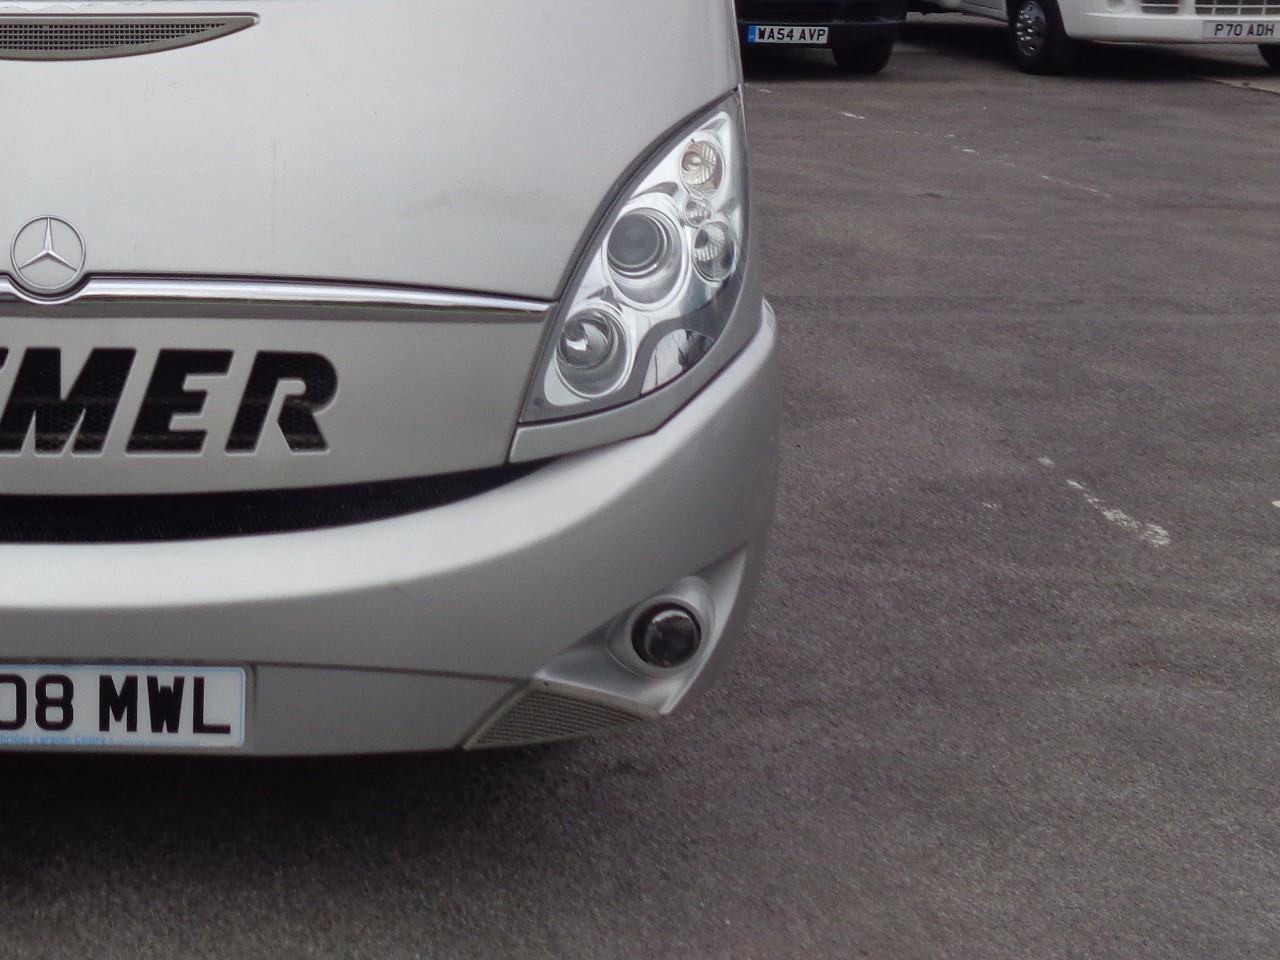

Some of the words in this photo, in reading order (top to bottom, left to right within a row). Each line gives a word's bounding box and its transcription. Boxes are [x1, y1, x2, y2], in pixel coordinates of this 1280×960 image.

[758, 27, 794, 40] WA54
[799, 28, 826, 41] AVP
[1214, 23, 1243, 36] P70
[1247, 23, 1275, 36] ADH
[99, 675, 231, 735] MWL
